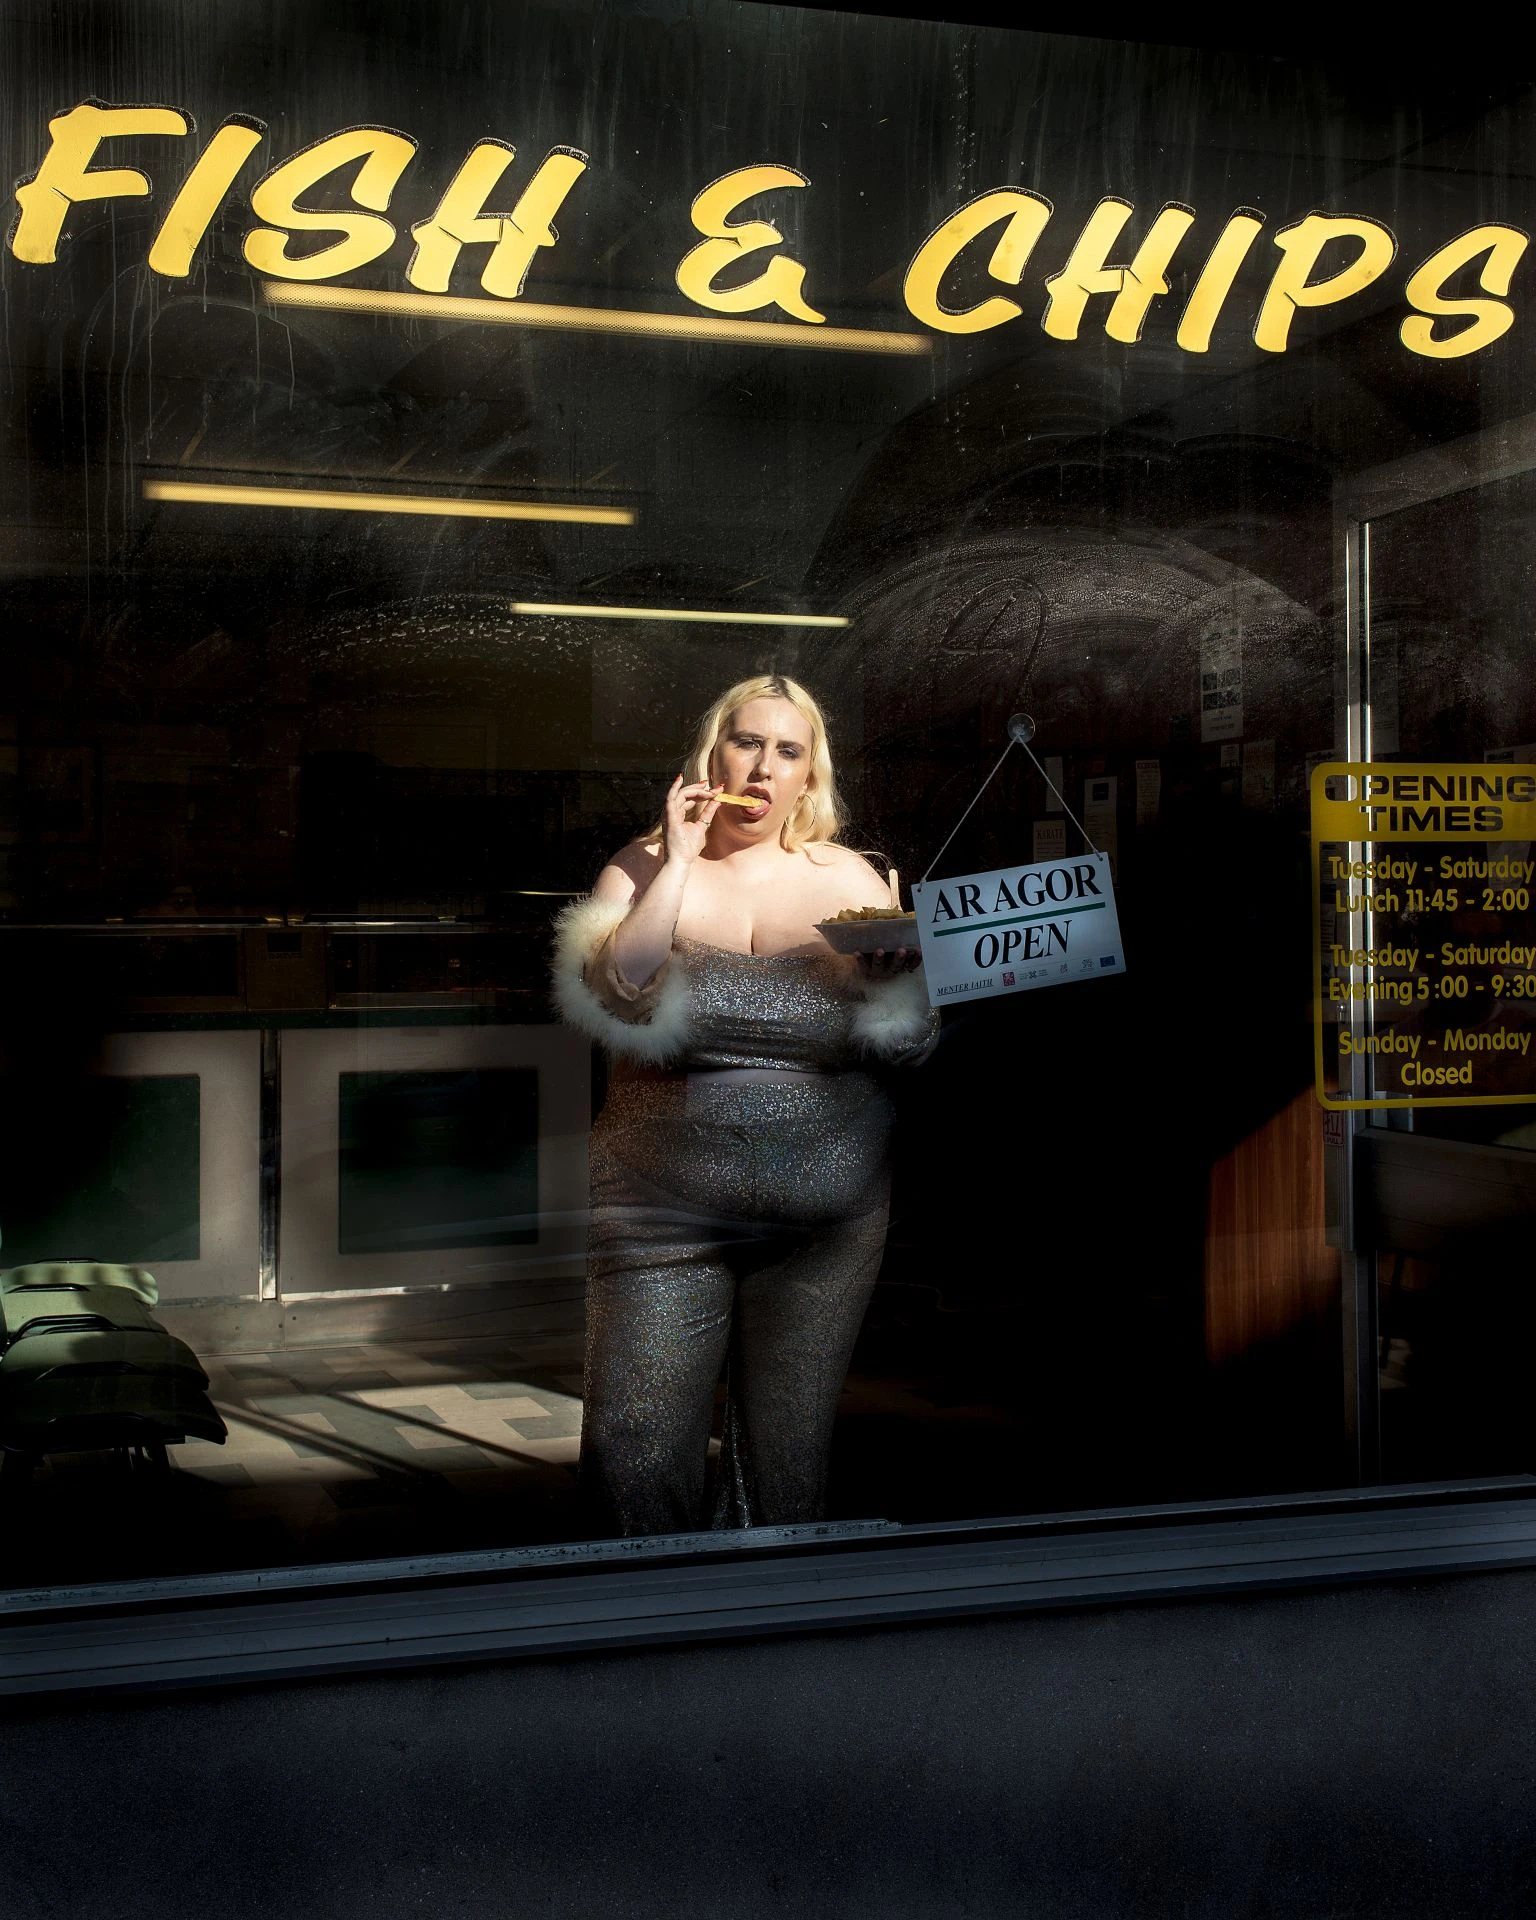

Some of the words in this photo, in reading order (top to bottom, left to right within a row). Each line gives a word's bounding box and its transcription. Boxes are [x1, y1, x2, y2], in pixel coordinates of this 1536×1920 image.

[6, 97, 590, 298] FISH
[675, 163, 827, 325] &
[902, 185, 1532, 360] CHIPS
[1325, 775, 1536, 802] OPENING
[1359, 805, 1504, 832] TIMES
[1328, 854, 1418, 886] Tuesday
[1439, 855, 1535, 884] Saturday
[931, 884, 987, 923] AR
[993, 864, 1102, 913] AGOR
[1335, 888, 1399, 913] Lunch
[1406, 888, 1458, 912] 11:45
[1482, 888, 1530, 911] 2:00
[974, 920, 1072, 969] OPEN
[1330, 942, 1419, 972] Tuesday
[1441, 940, 1536, 970] Saturday
[1329, 976, 1413, 1006] Evening
[1491, 974, 1536, 998] 9:30
[1339, 1028, 1421, 1059] Sunday
[1443, 1026, 1531, 1056] Monday
[1400, 1060, 1473, 1086] Closed
